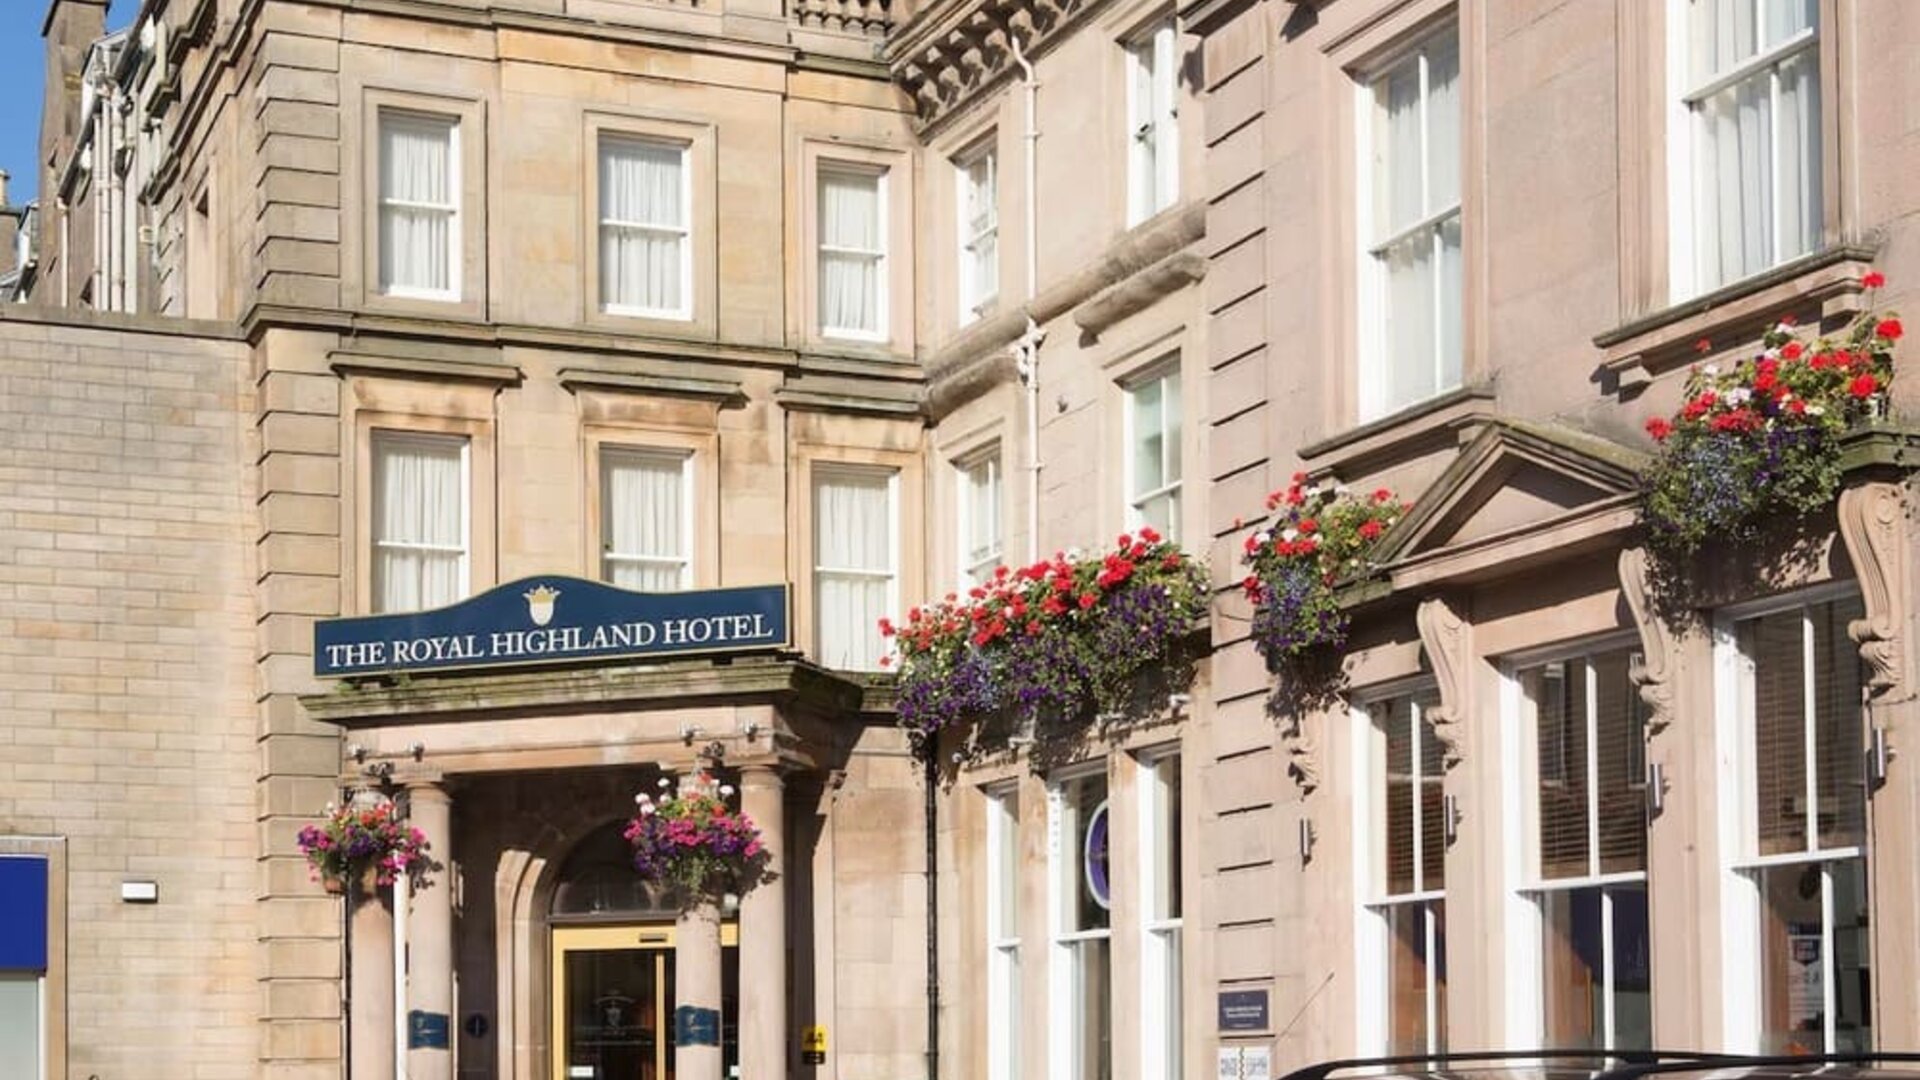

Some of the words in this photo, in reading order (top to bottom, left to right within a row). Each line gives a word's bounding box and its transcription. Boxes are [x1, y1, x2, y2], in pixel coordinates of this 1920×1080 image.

[326, 641, 387, 667] THE
[393, 635, 484, 663] ROYAL
[490, 622, 656, 656] HIGHLAND
[663, 614, 773, 644] HOTEL
